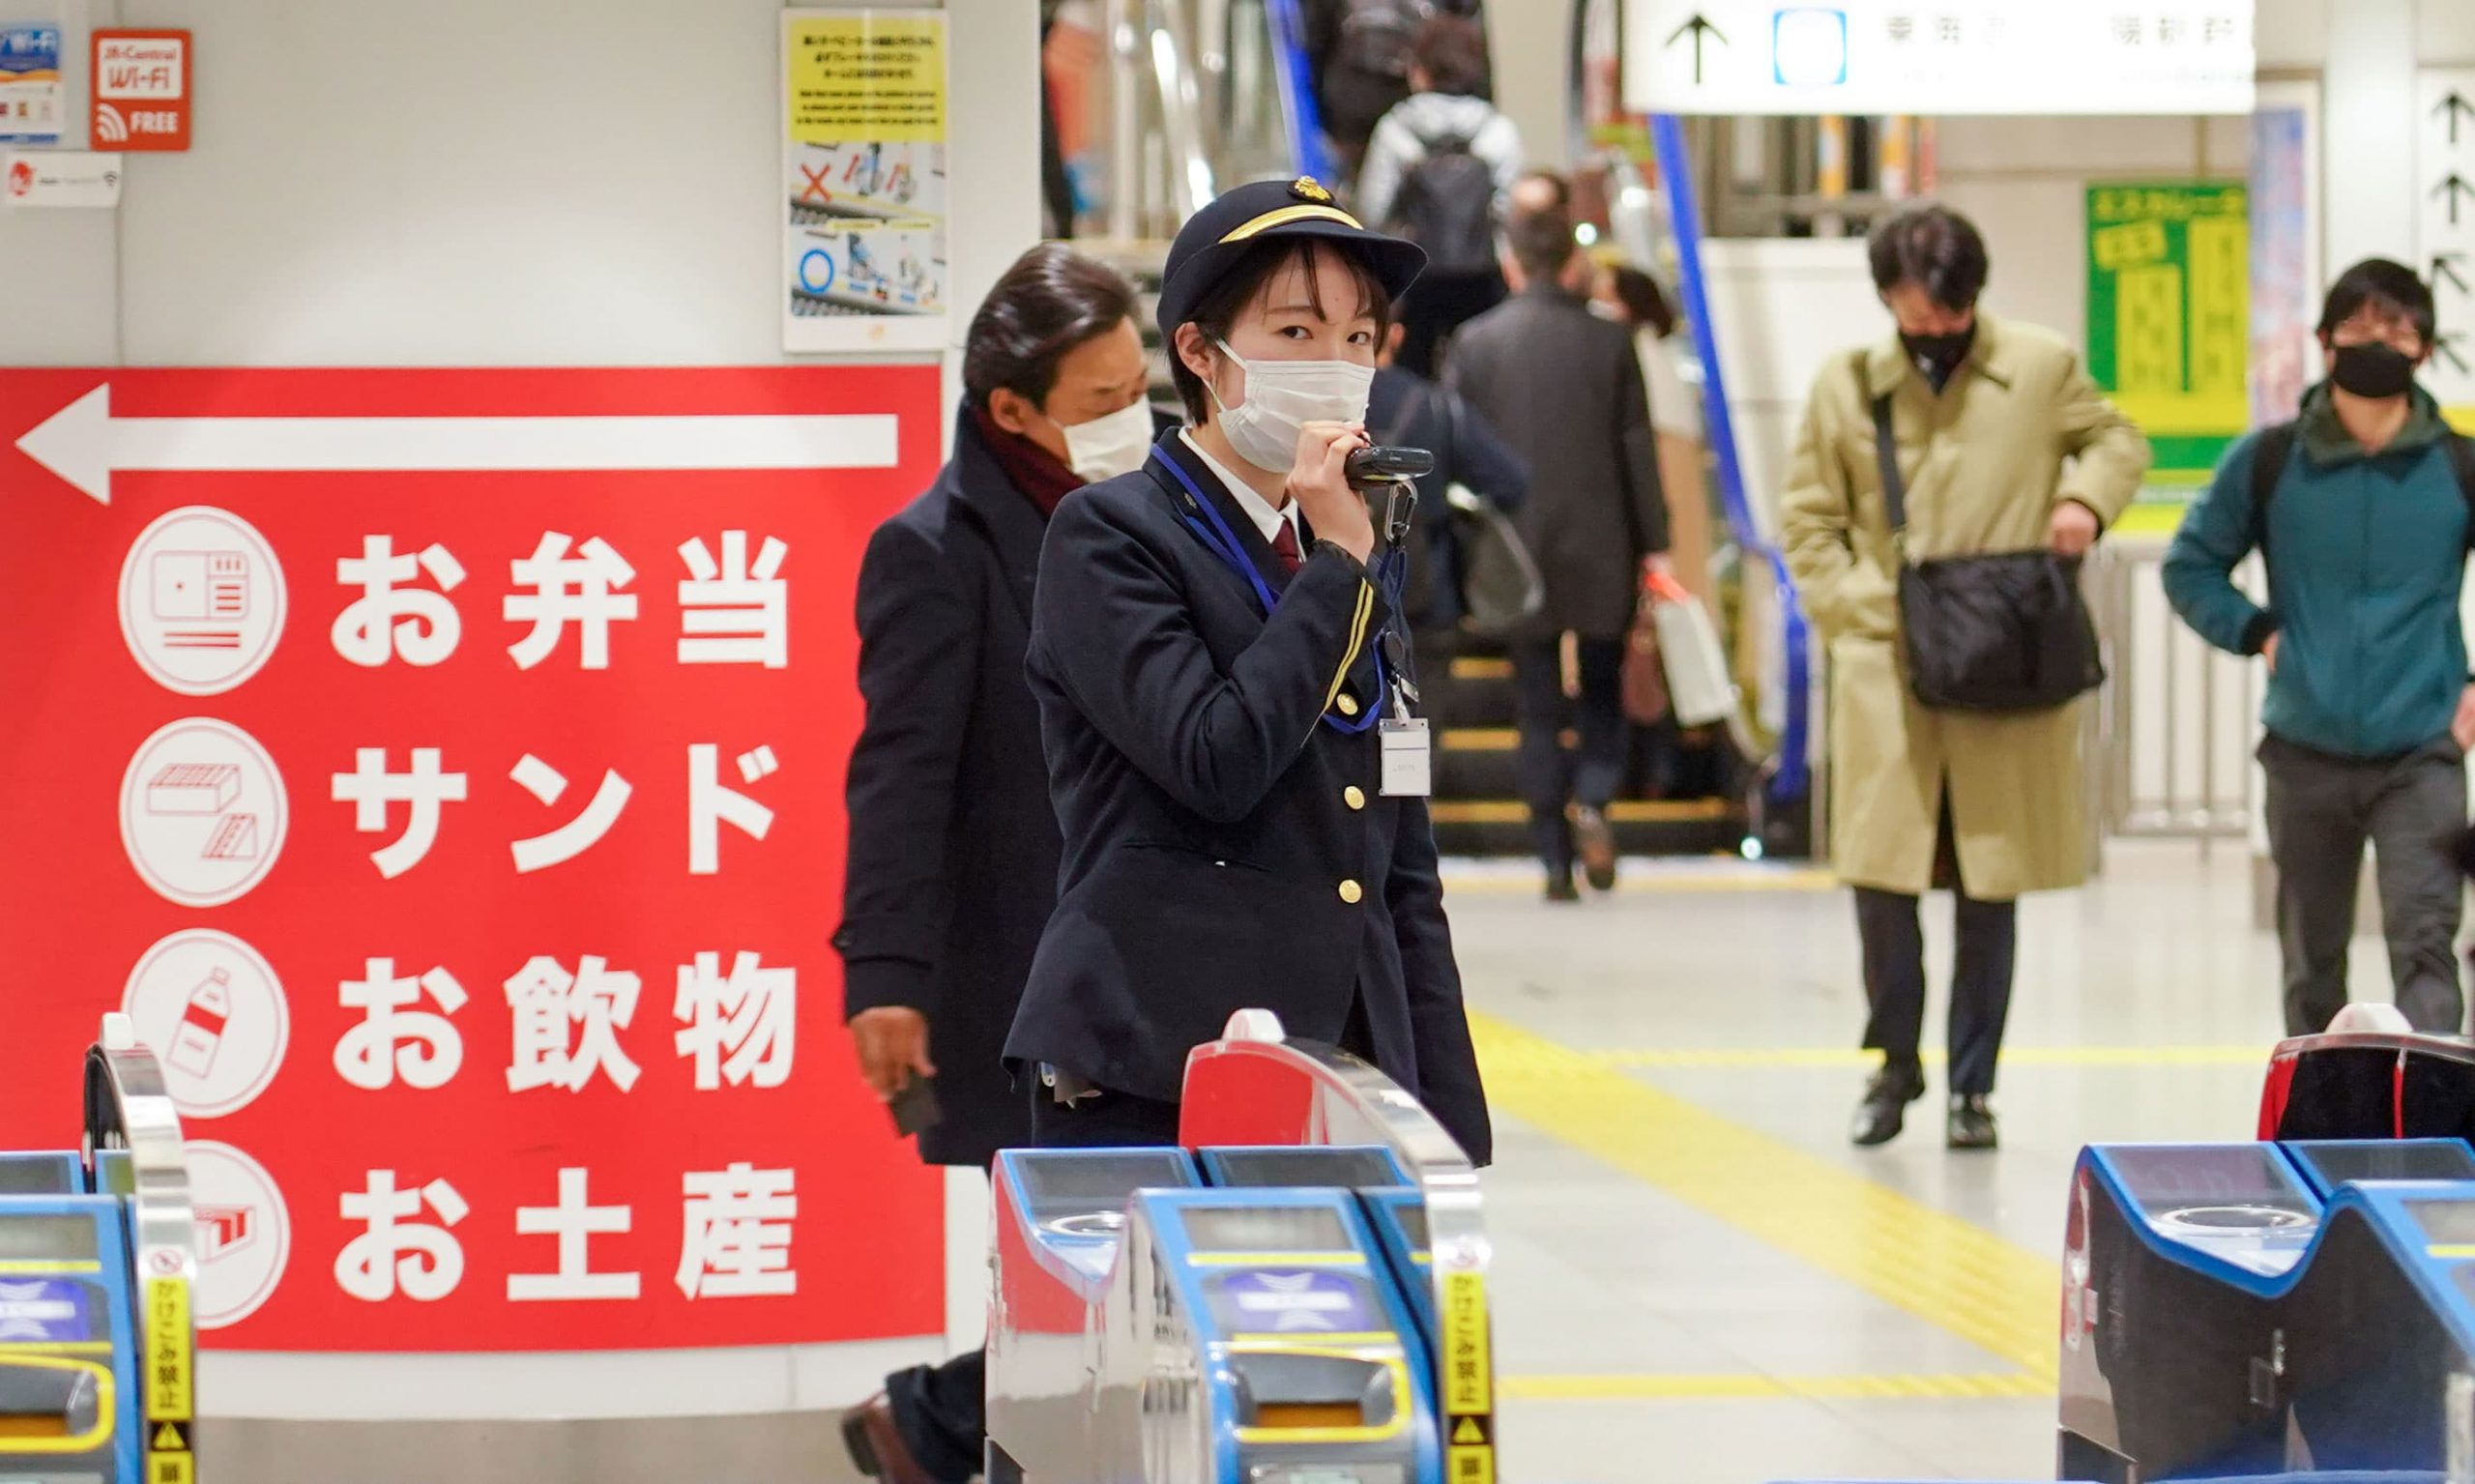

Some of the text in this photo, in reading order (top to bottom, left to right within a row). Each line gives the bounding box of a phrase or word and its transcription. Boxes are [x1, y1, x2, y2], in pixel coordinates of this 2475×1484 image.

[103, 45, 177, 61] JR-Central
[108, 67, 170, 90] Wi-Fi
[130, 111, 179, 133] FREE
[331, 530, 788, 669] お弁当
[331, 743, 779, 879] サンド
[333, 950, 798, 1093] お飲物
[334, 1162, 798, 1301] お土産
